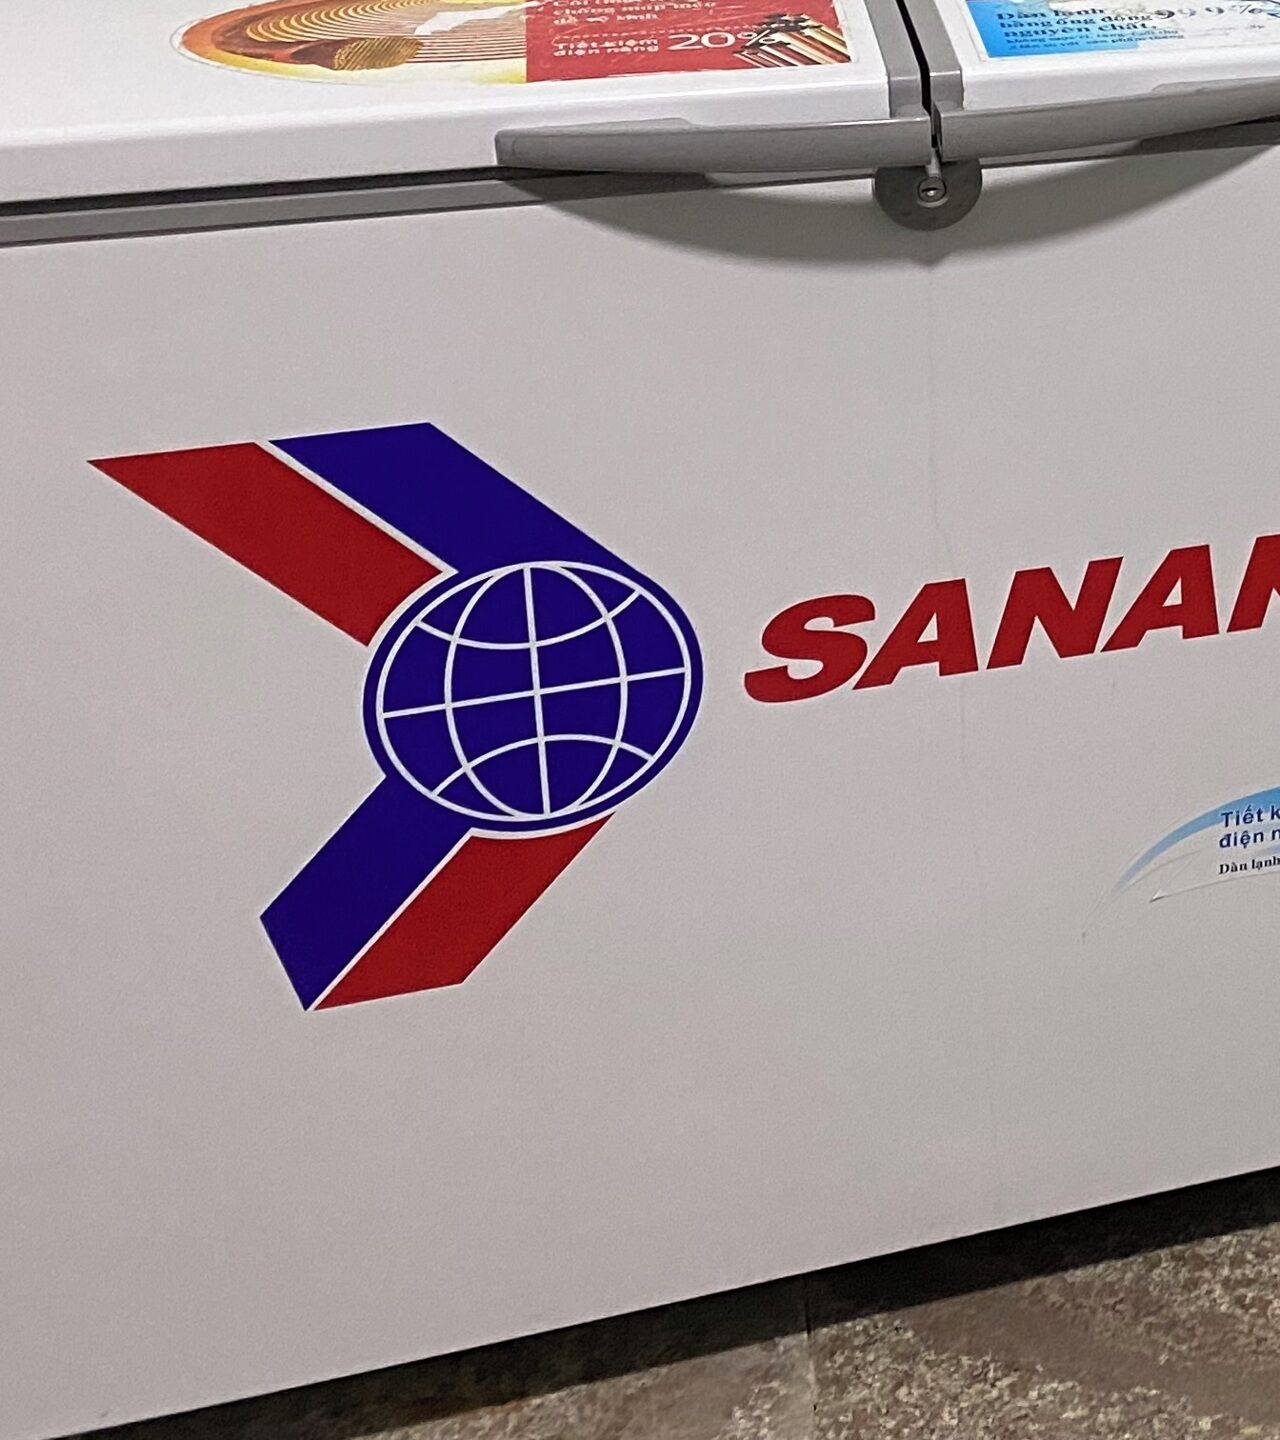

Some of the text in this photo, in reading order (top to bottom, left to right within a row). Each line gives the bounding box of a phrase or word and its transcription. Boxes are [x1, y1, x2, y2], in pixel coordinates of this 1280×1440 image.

[666, 29, 779, 51] 20%
[1220, 804, 1264, 828] Tiết
[1219, 829, 1265, 849] điện
[1218, 861, 1248, 875] Dàn
[1251, 855, 1280, 871] lạnh
